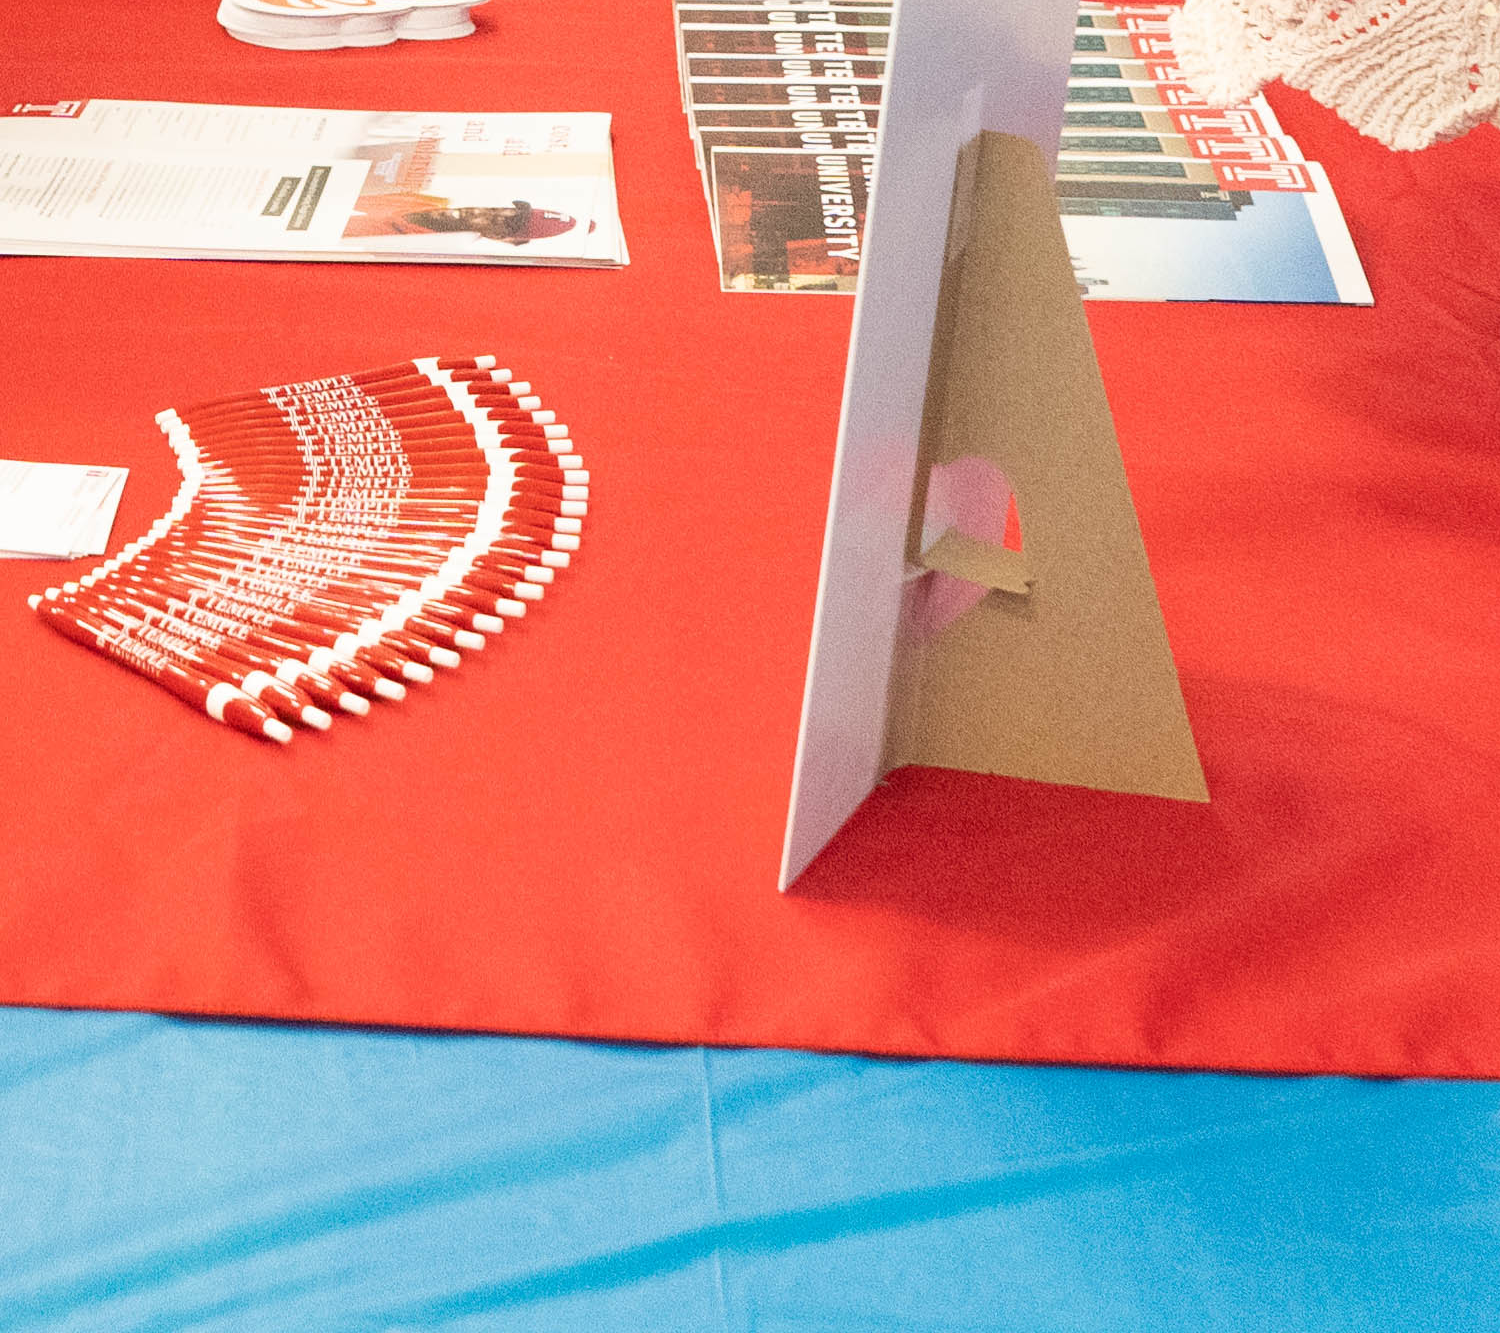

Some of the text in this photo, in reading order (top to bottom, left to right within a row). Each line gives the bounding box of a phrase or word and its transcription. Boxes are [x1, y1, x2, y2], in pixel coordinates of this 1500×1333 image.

[816, 155, 860, 261] UNIVERSITY
[281, 374, 355, 396] TEMPLE
[291, 386, 365, 406] TEMPLE
[304, 396, 379, 414] TEMPLE
[306, 407, 384, 426] TEMPLE
[312, 418, 393, 435] TEMPLE
[321, 429, 402, 446] TEMPLE
[321, 442, 403, 456] TEMPLE
